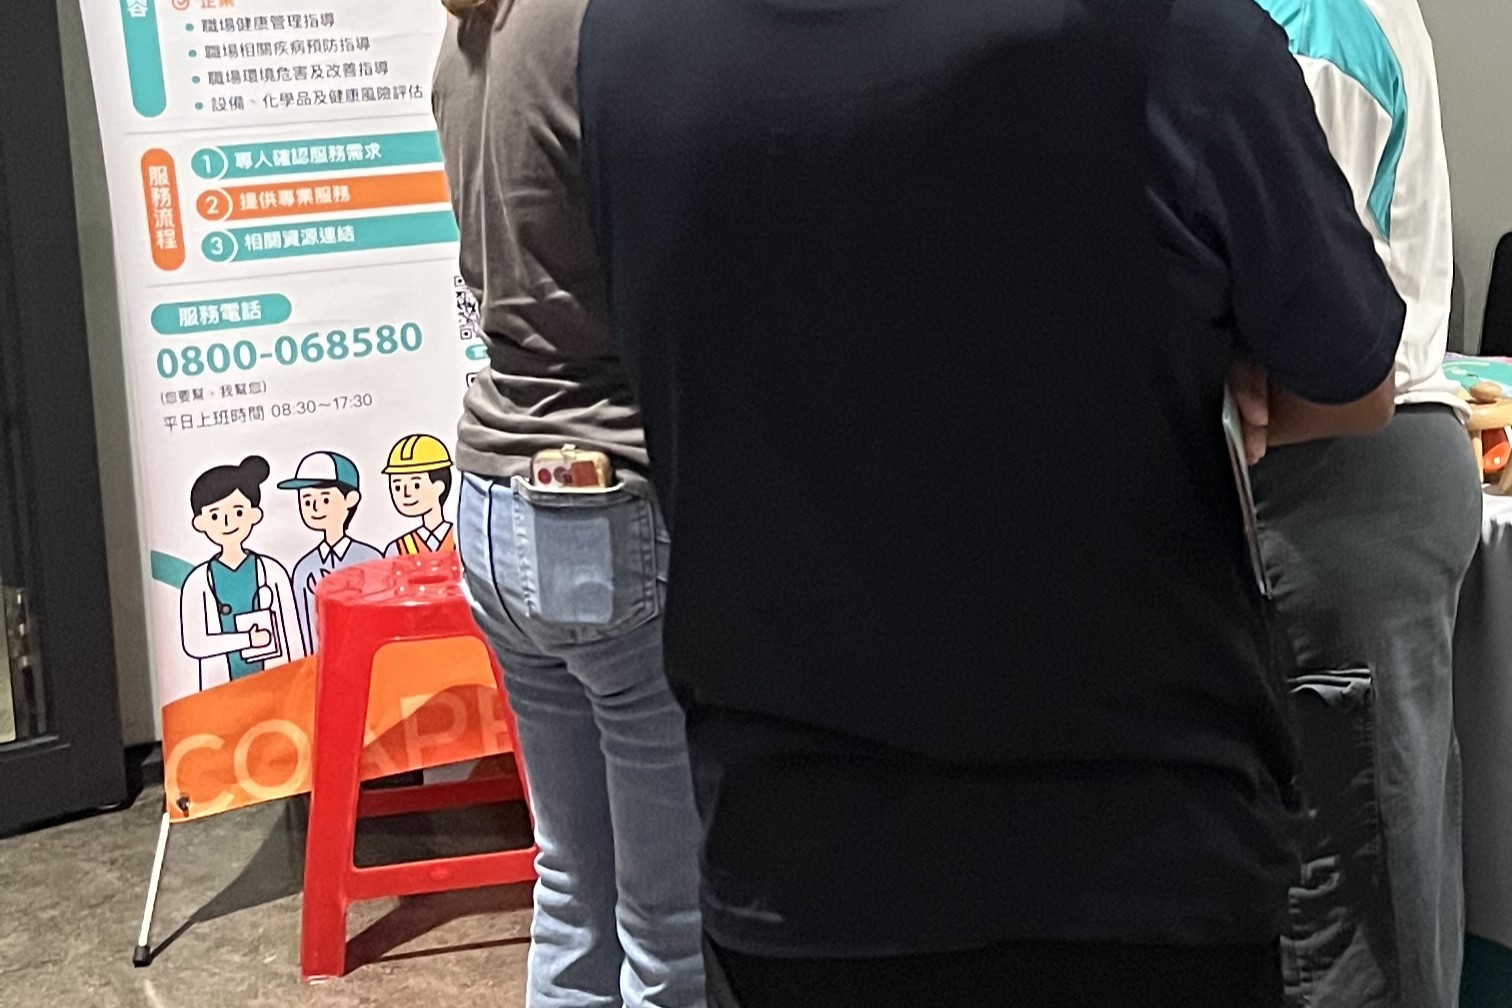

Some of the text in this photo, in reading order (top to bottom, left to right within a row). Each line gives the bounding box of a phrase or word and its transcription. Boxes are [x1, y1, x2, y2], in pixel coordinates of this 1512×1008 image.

[201, 12, 335, 34] 職場健康管理指導
[204, 36, 371, 60] 職場相關疾病預防指導
[208, 61, 389, 86] 職場環境危害及改善指導
[211, 84, 424, 113] 設備、化學品及健康風險評估
[234, 142, 382, 169] 專人確認服務需求
[148, 166, 177, 250] 服務流程
[239, 185, 351, 211] 提供專業服務
[244, 226, 355, 252] 相關資源連結
[178, 300, 263, 328] 服務電話
[156, 322, 424, 379] 0800-068580
[163, 405, 265, 432] 平日上班時間
